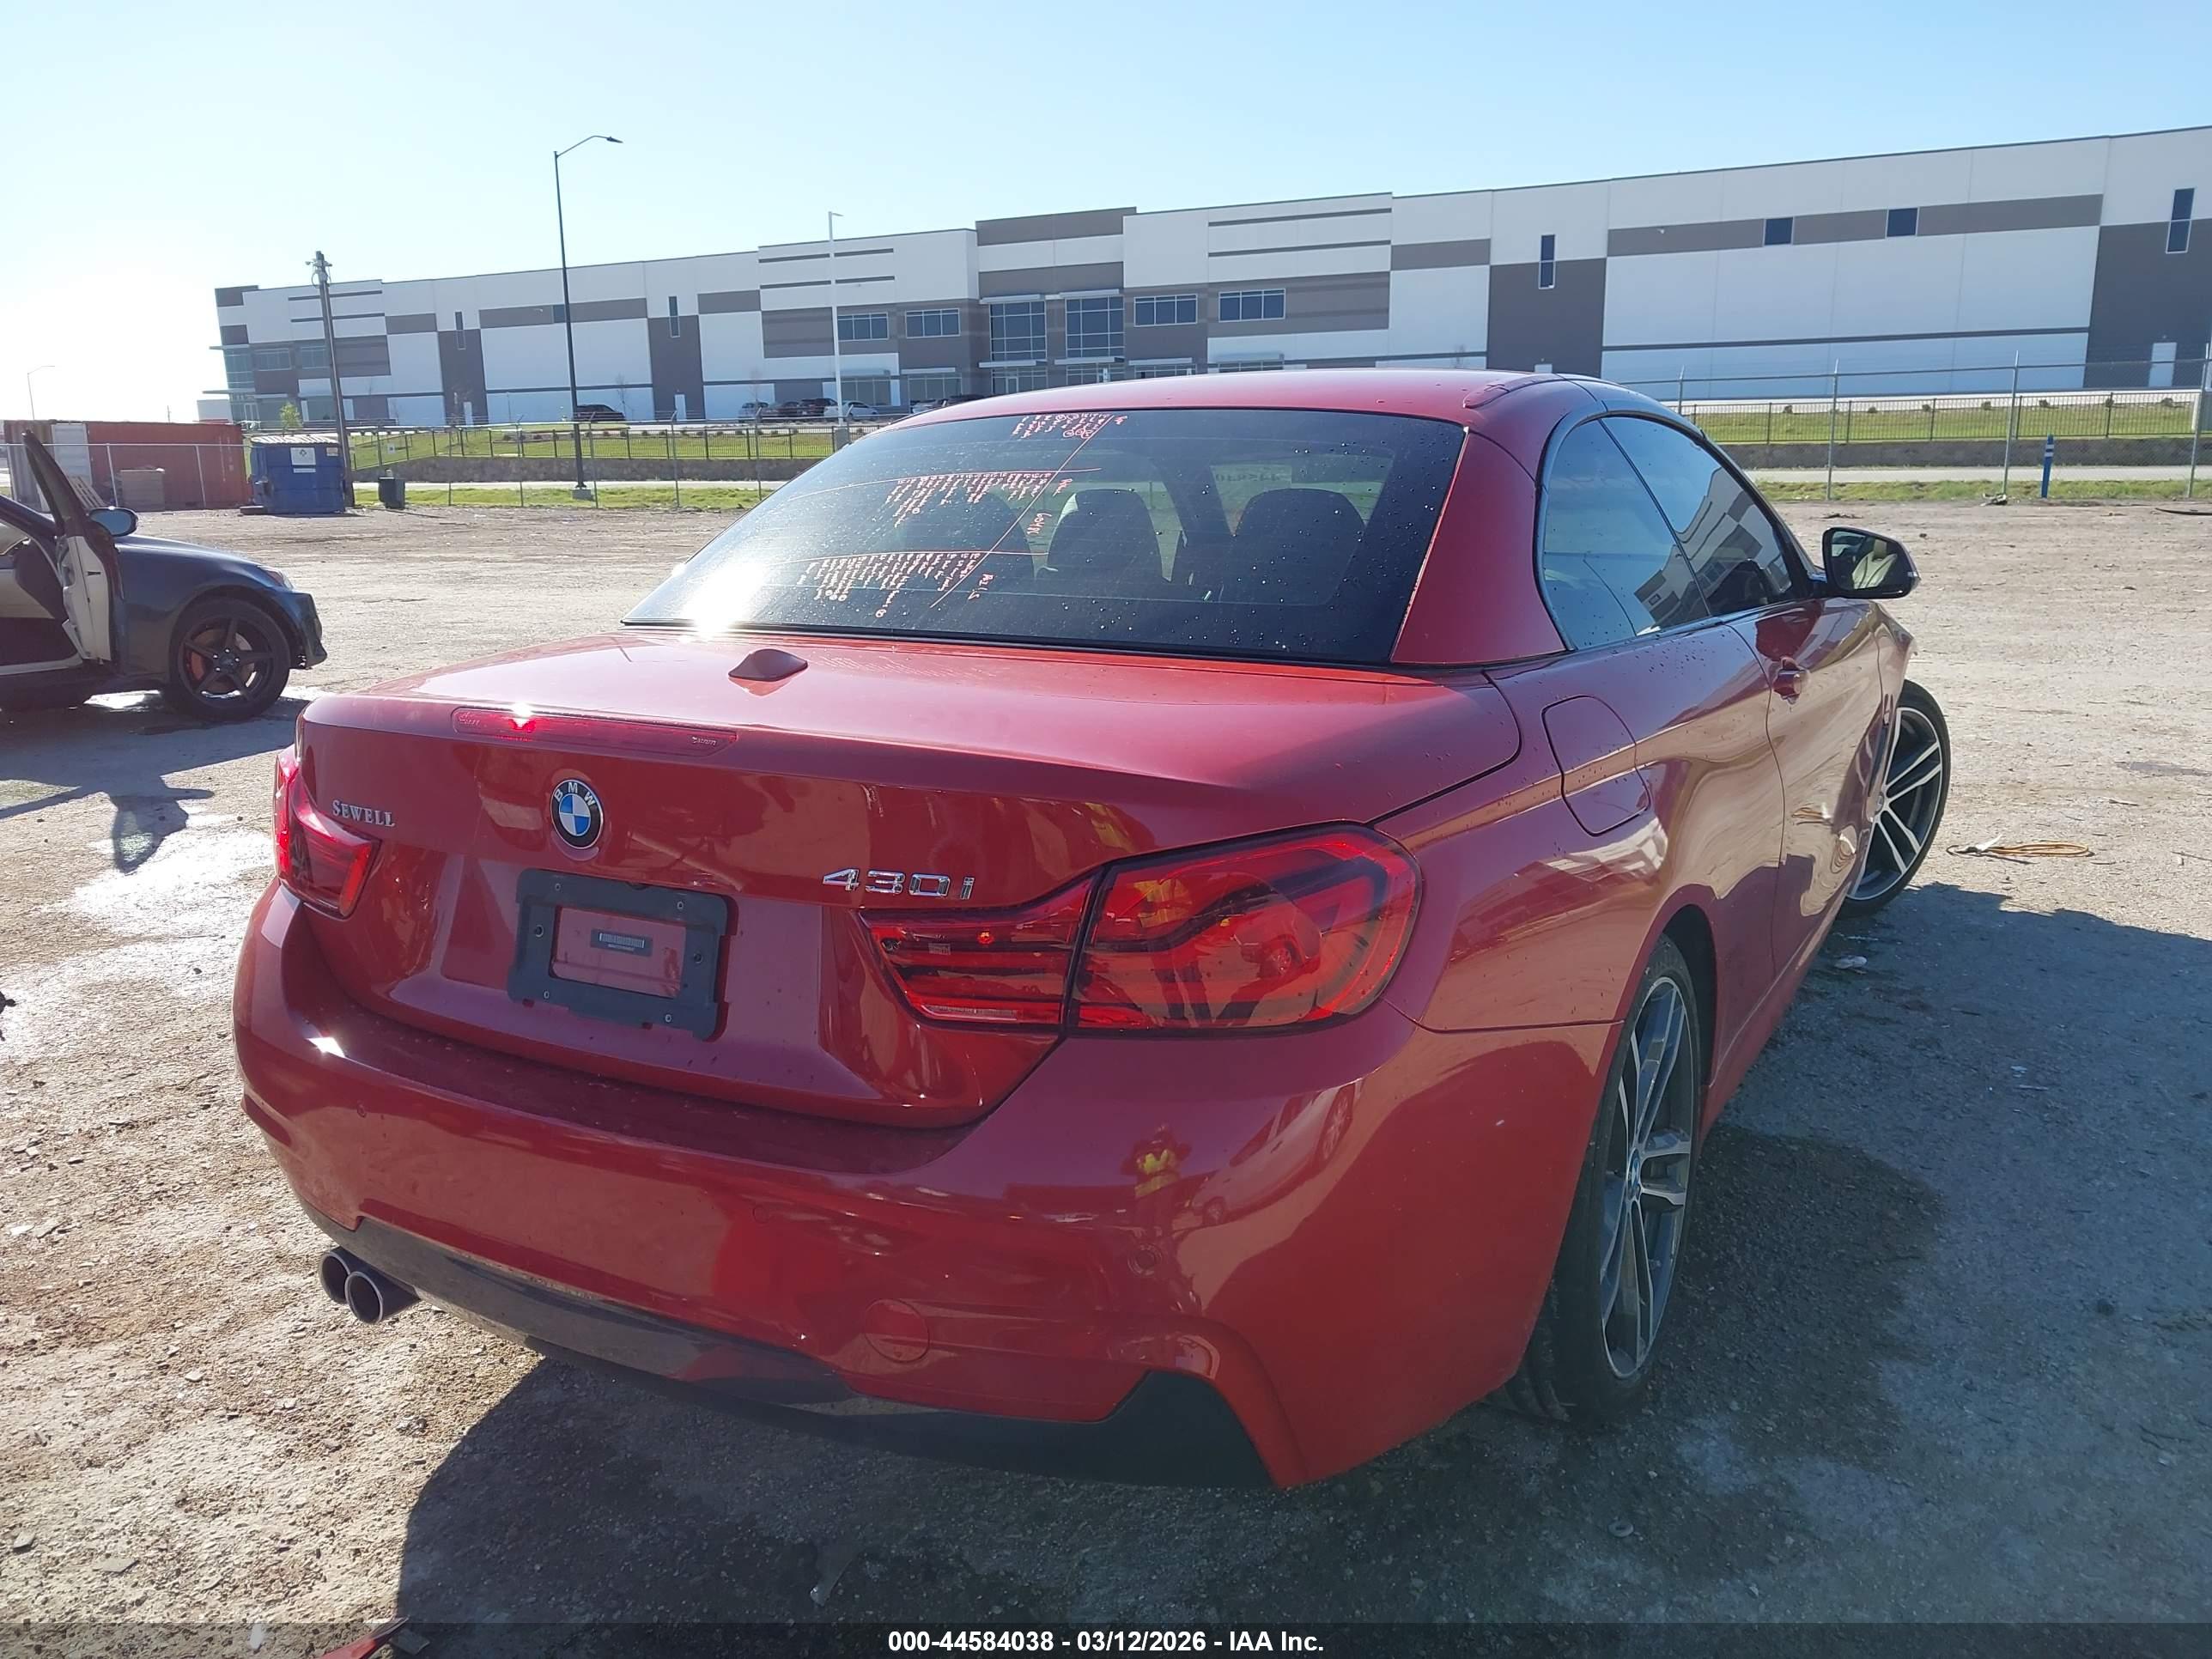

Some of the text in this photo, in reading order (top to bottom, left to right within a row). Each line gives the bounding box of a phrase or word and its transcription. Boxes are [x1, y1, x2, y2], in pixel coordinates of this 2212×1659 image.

[554, 782, 596, 806] BMW
[332, 799, 396, 827] SEWELL
[822, 867, 975, 900] 430i
